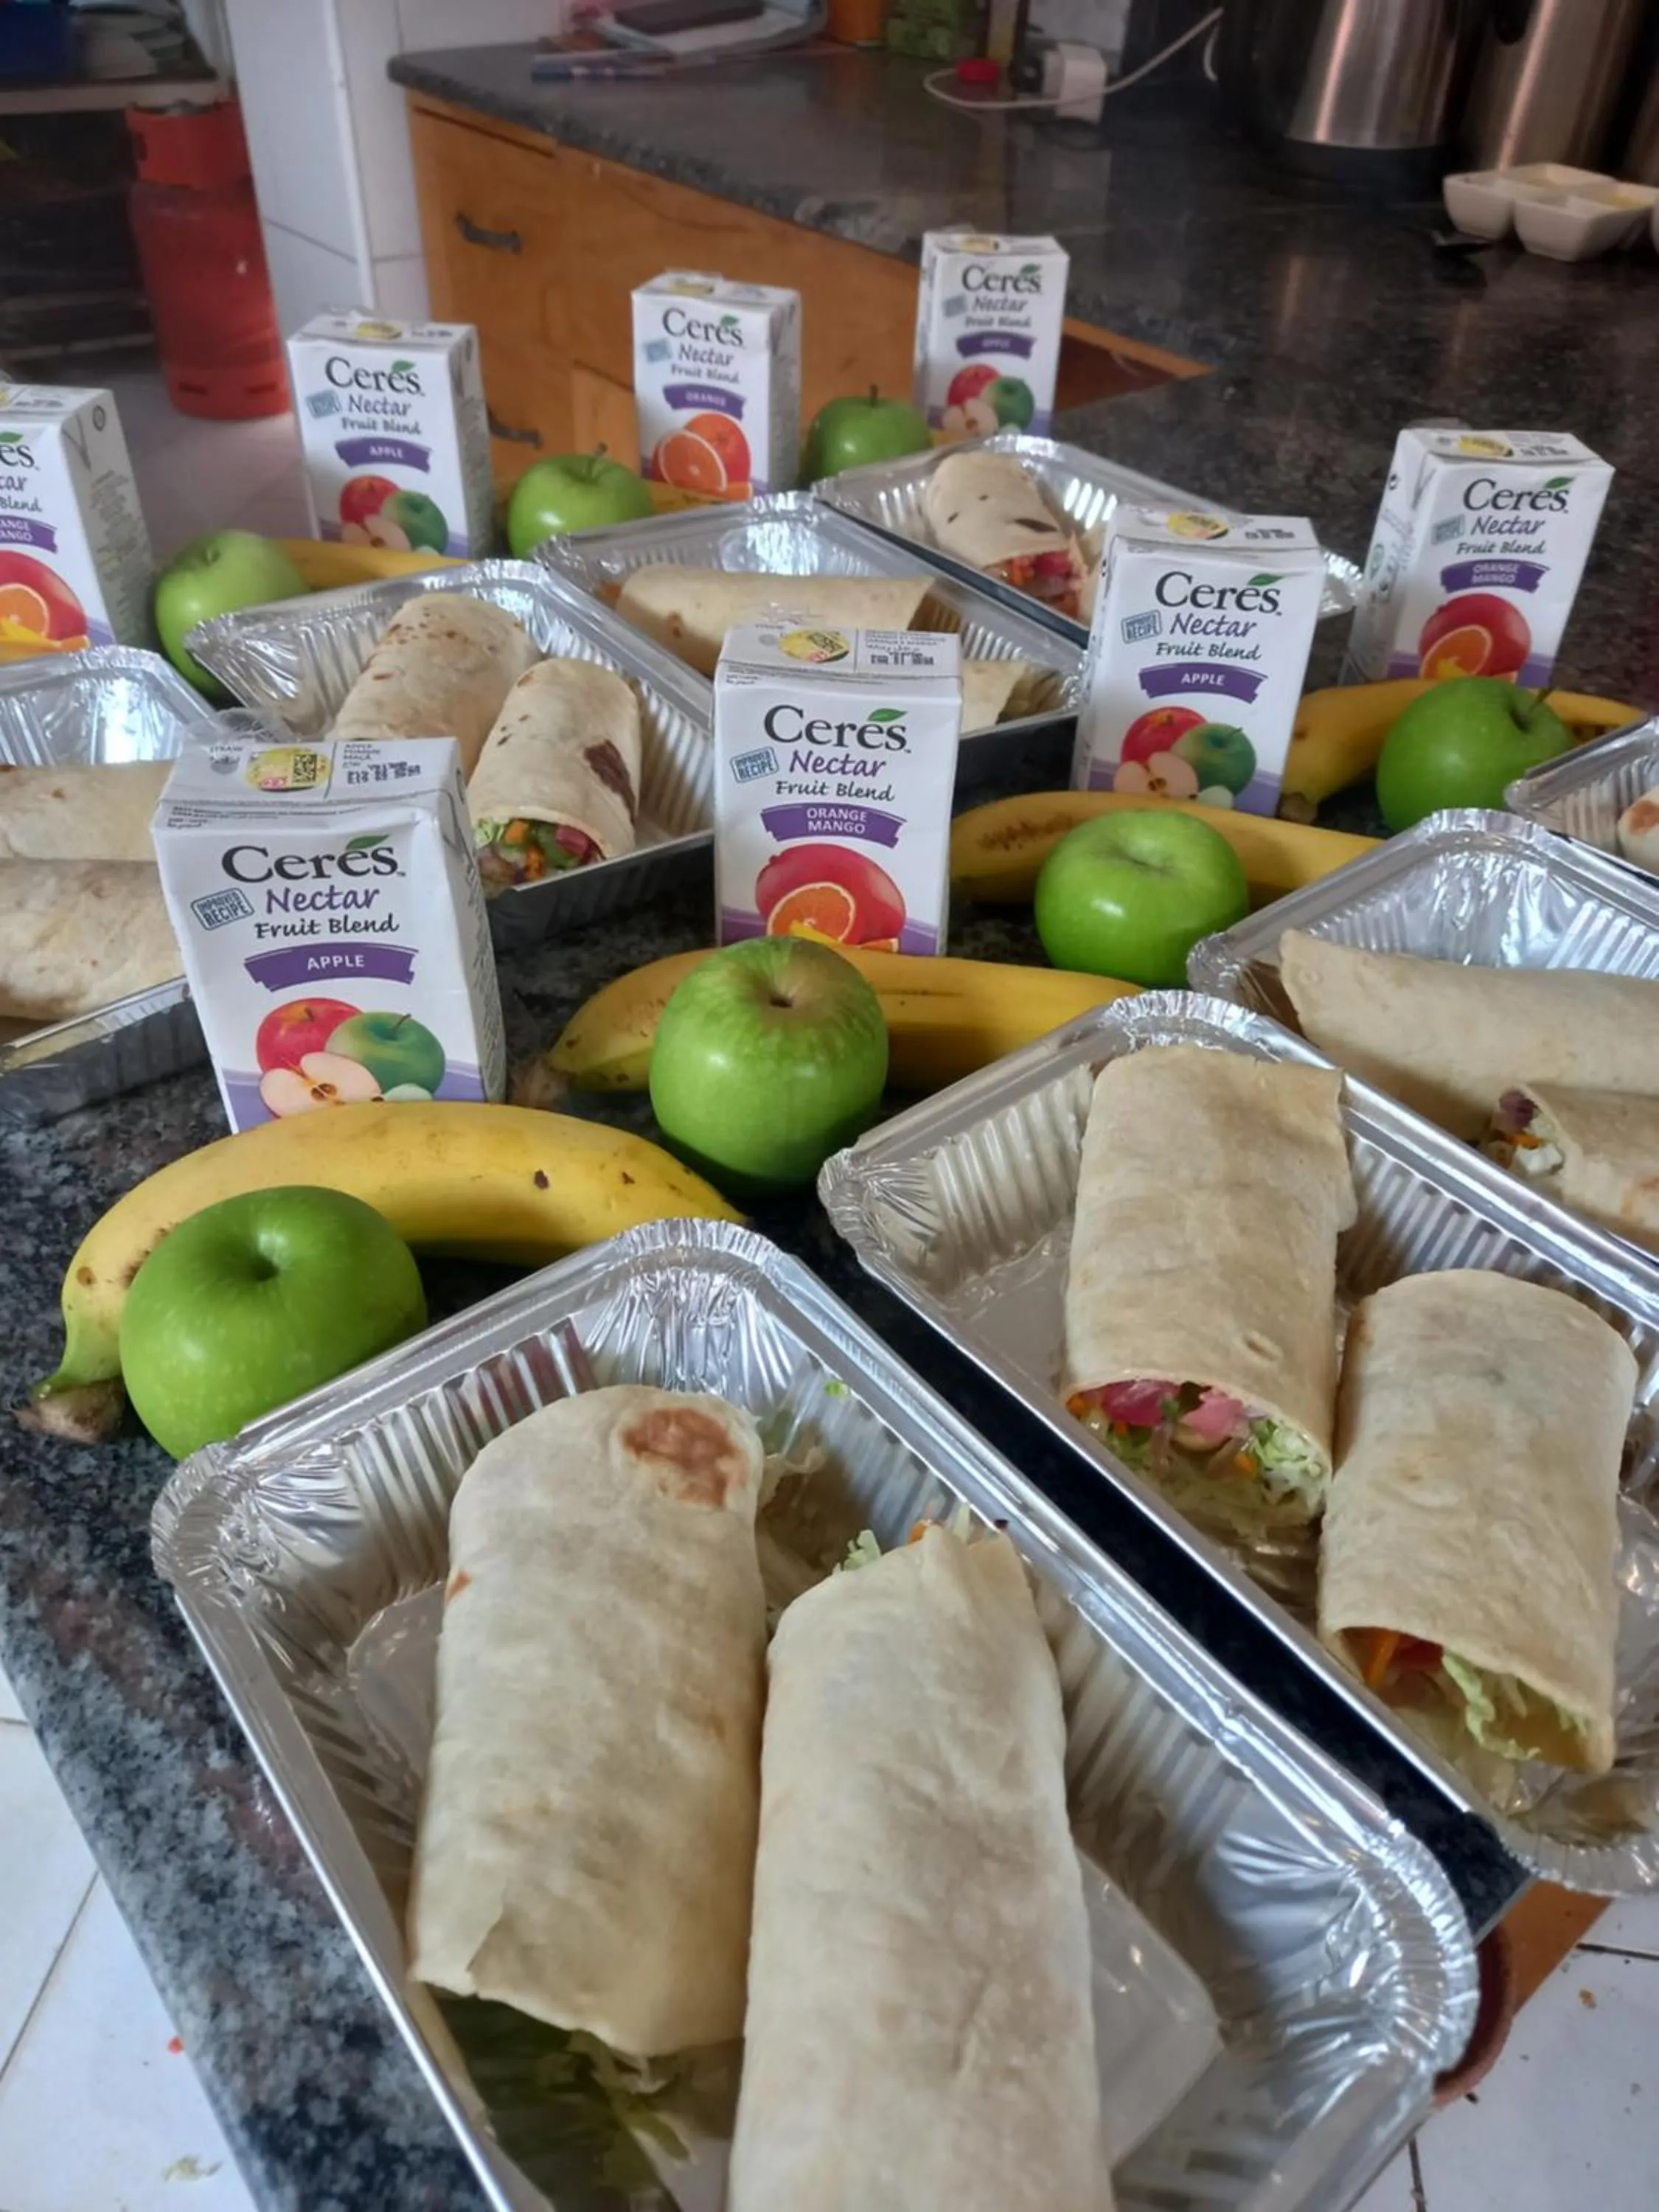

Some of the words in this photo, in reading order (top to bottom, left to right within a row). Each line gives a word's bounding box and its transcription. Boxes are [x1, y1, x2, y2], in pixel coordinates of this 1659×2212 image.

[973, 296, 1029, 313] Nectar
[678, 343, 734, 367] Nectar
[348, 394, 412, 417] Nectar
[341, 417, 377, 431] Fruit
[383, 417, 422, 436] Blend
[1470, 515, 1546, 535] Nectar
[1455, 541, 1496, 555] Fruit
[1499, 539, 1547, 555] Blend
[1169, 613, 1257, 638] Nectar
[1155, 641, 1203, 657] Fruit
[1208, 643, 1262, 661] Blend
[1180, 672, 1225, 686] APPLE
[789, 750, 888, 778] Nectar
[775, 780, 830, 796] Fruit
[836, 781, 896, 802] Blend
[807, 808, 868, 823] ORANGE
[807, 820, 866, 835] MANGO
[266, 885, 380, 914] Nectar
[204, 900, 248, 926] RECIPE
[254, 919, 321, 939] Fruit
[329, 913, 400, 934] Blend
[307, 954, 365, 971] APPLE
